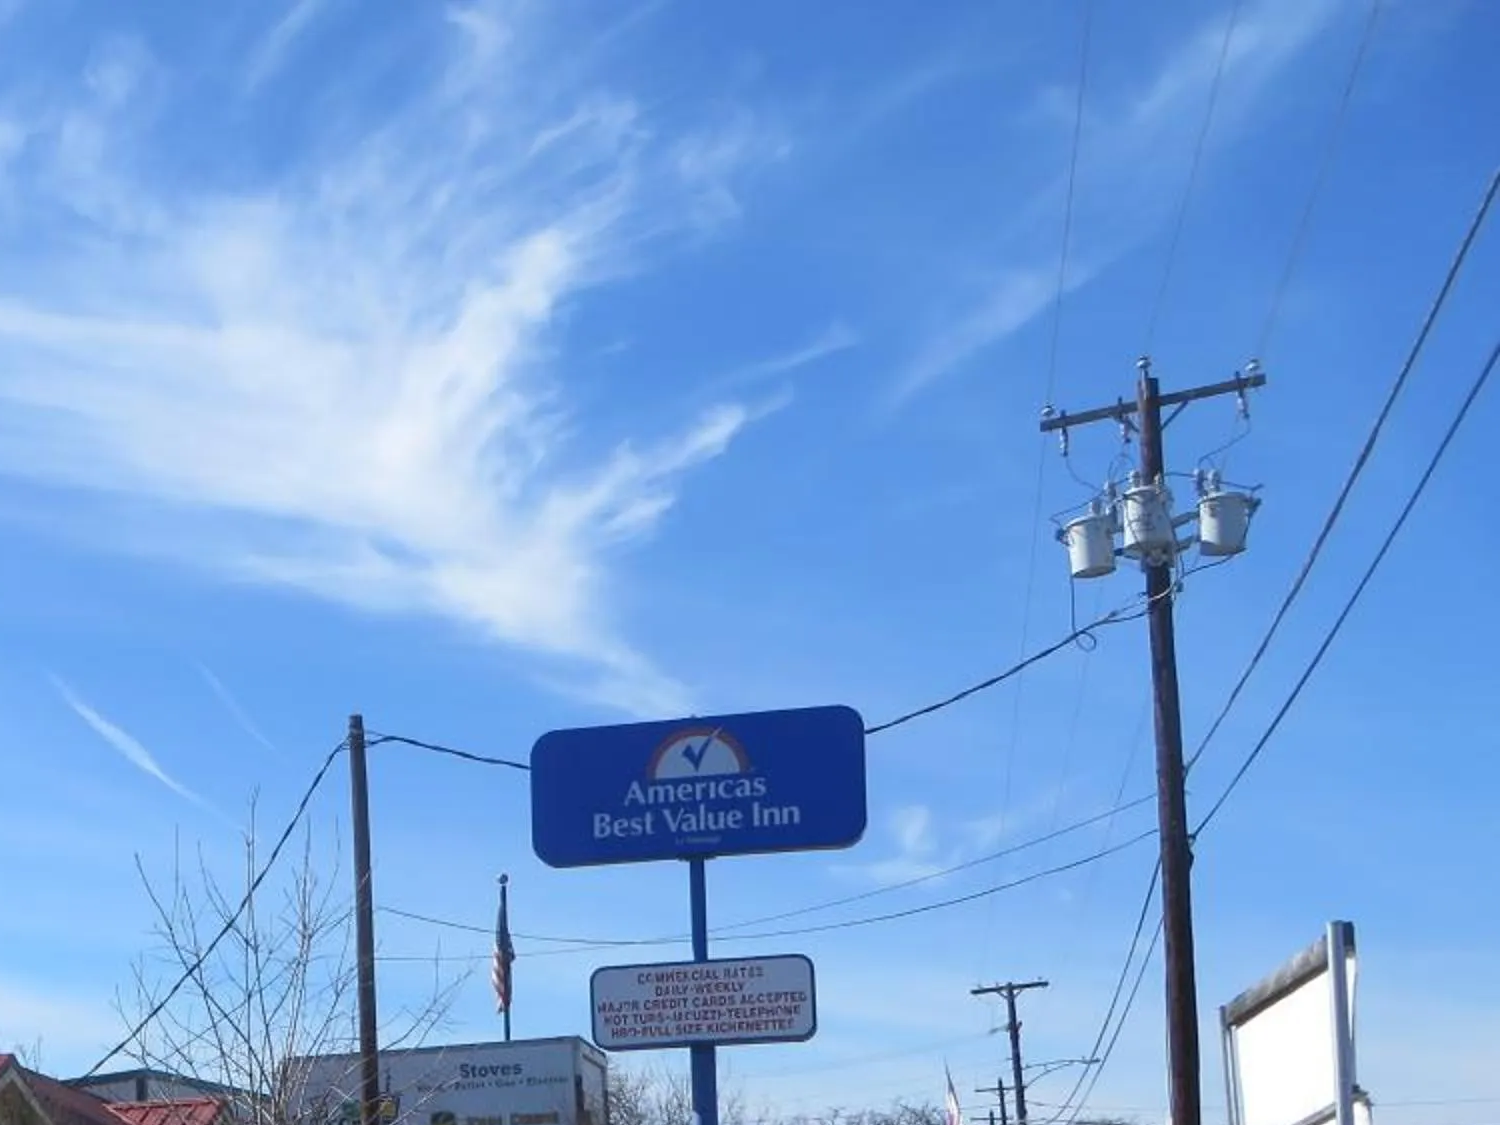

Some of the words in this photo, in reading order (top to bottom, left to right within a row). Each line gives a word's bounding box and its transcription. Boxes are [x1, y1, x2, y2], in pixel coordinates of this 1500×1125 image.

[623, 777, 767, 807] Americas
[593, 811, 655, 839] Best
[662, 803, 743, 833] Value
[752, 801, 800, 827] Inn
[643, 997, 688, 1011] CREDIT
[459, 1062, 523, 1079] Stoves
